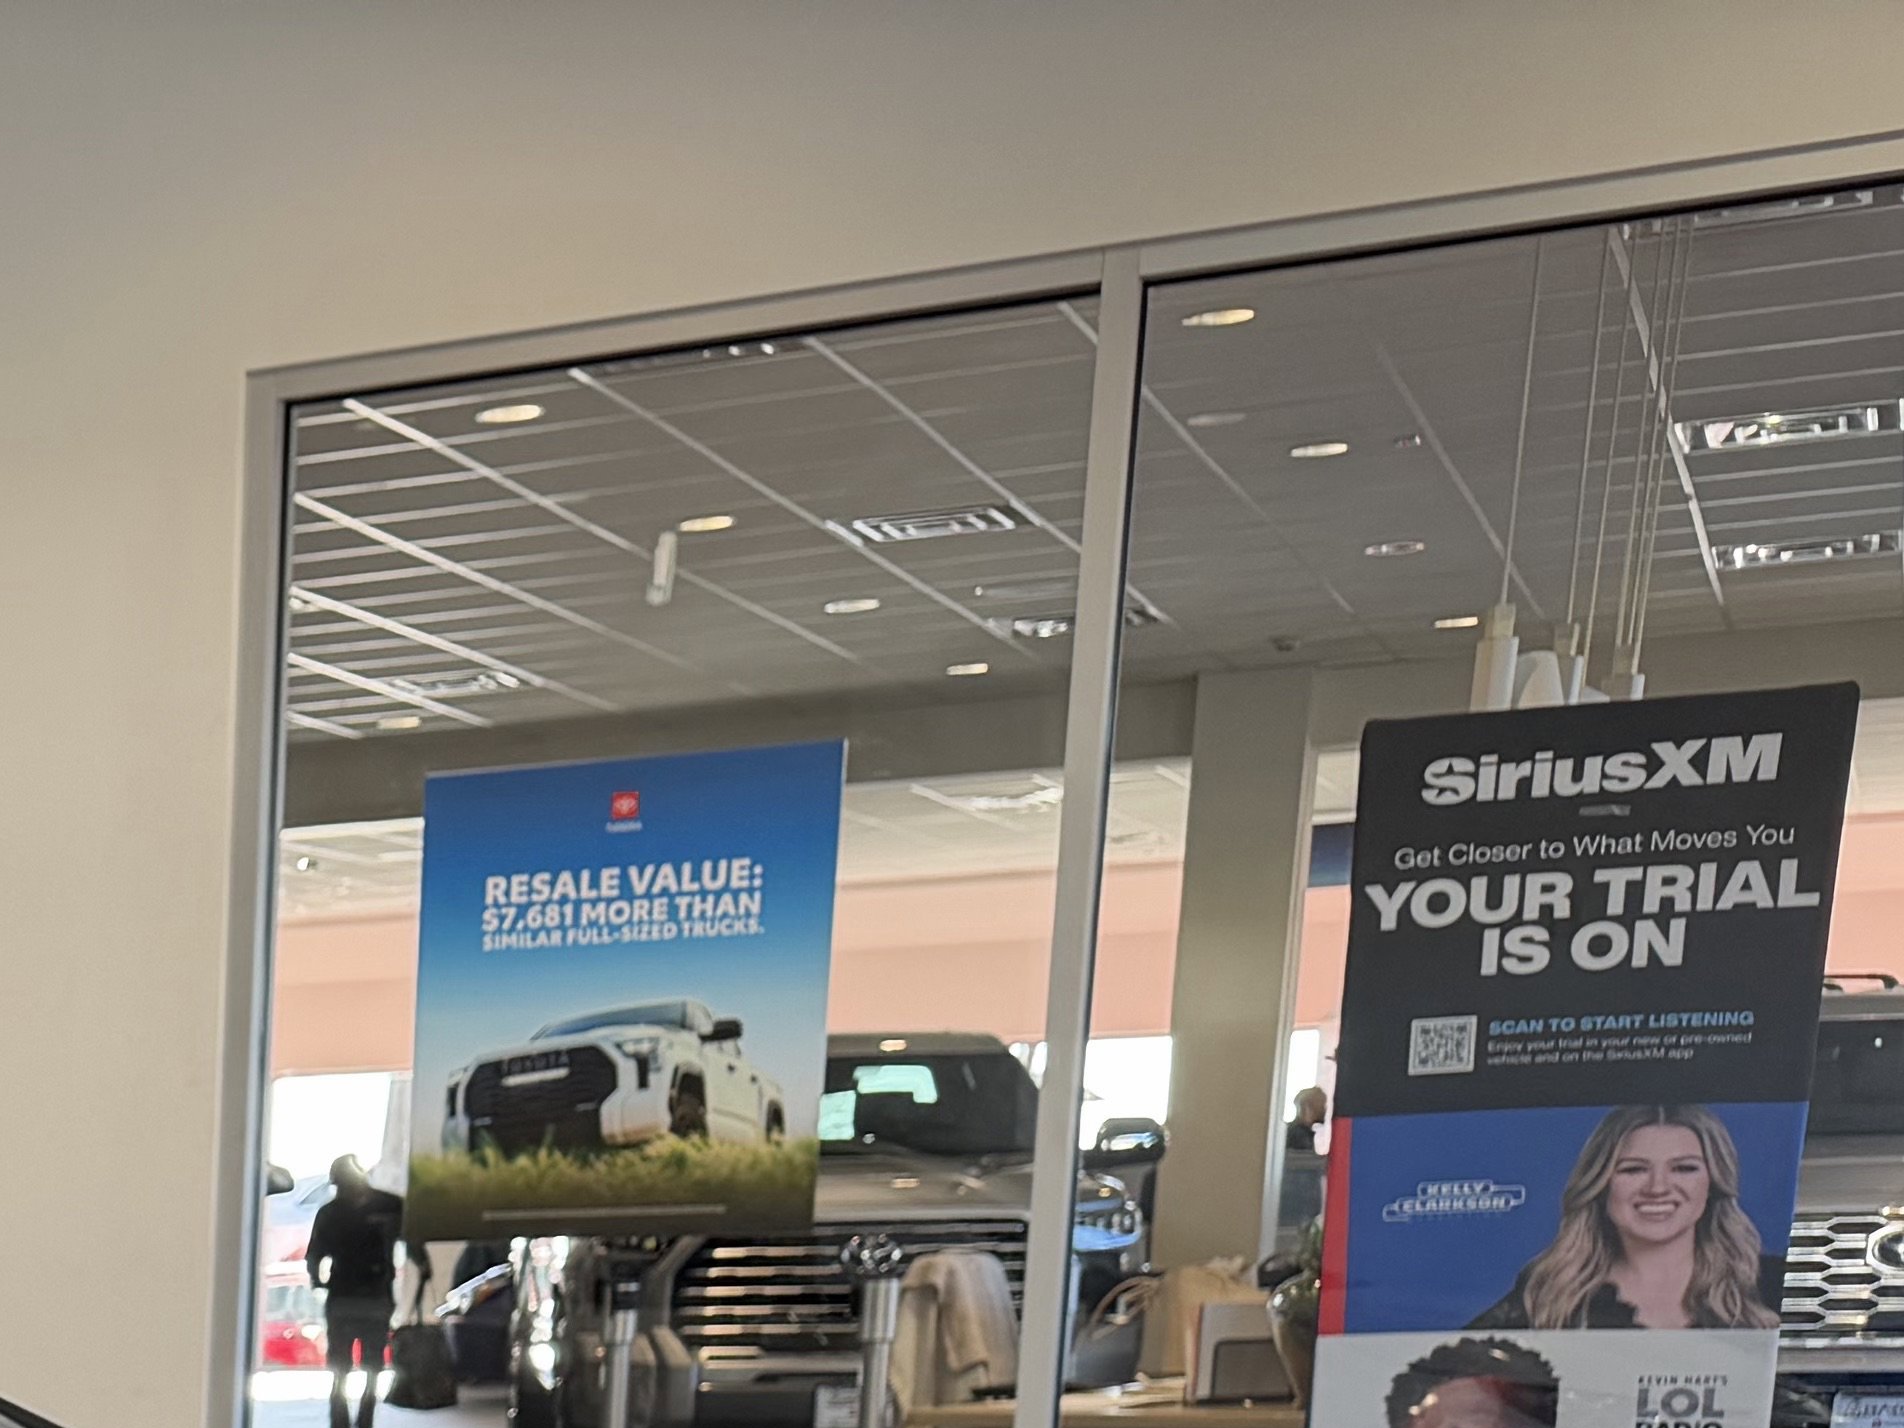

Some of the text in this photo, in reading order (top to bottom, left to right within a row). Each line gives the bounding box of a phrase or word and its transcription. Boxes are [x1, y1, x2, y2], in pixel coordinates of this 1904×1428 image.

[1421, 733, 1782, 806] SiriusXM
[1394, 824, 1795, 871] Get Closer to What Moves You
[485, 857, 763, 906] RESALE VALUE:
[1364, 858, 1821, 931] YOUR TRIAL
[482, 890, 761, 932] $7,681 MORE THAN
[483, 917, 765, 951] SIMILAR FULL-SIZED TRUCKS.
[1480, 918, 1687, 976] IS ON
[1489, 1010, 1754, 1036] SCAN TO START LISTENING
[1427, 1183, 1485, 1195] KELLY
[1636, 1388, 1724, 1418] LOL
